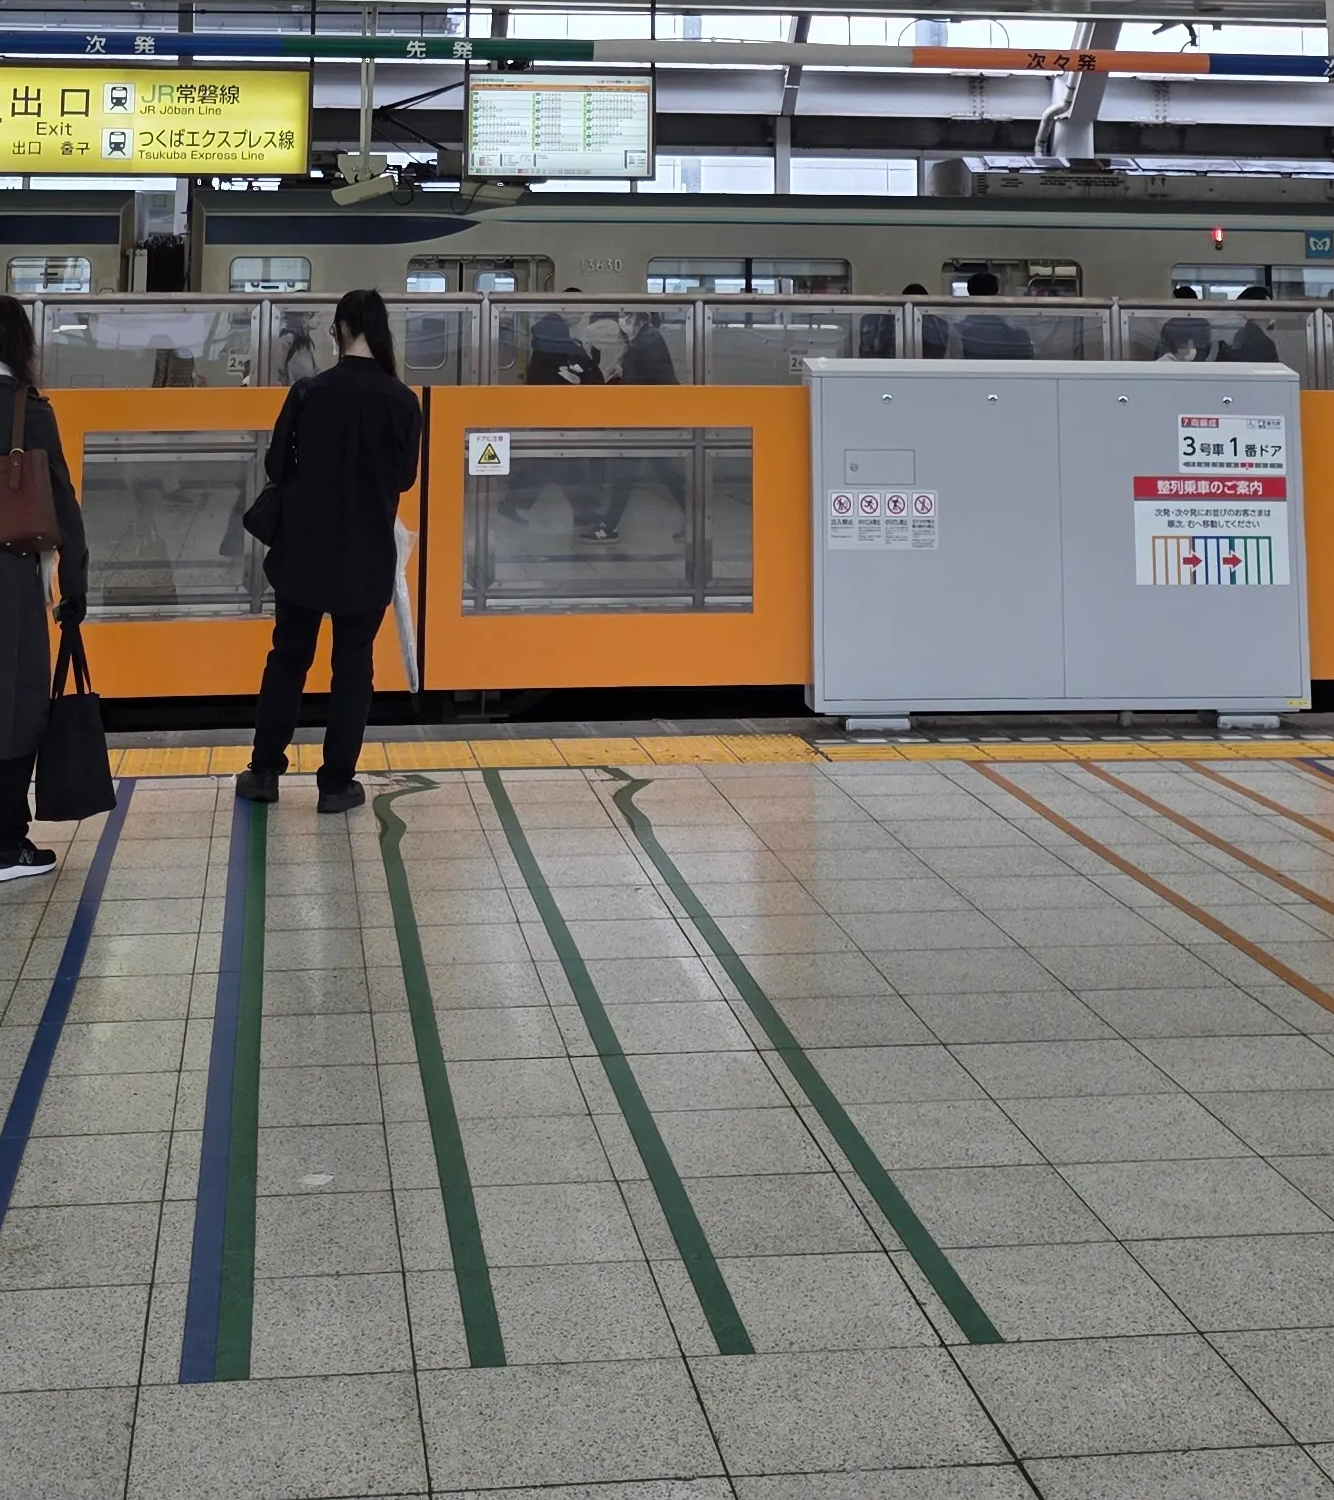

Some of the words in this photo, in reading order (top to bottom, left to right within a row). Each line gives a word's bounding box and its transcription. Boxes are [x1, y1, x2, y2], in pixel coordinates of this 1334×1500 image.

[85, 35, 156, 55] 次発
[406, 40, 473, 59] 先発
[1026, 53, 1097, 71] 次々発
[11, 85, 90, 117] 出口
[141, 83, 240, 105] JR常磐線
[139, 106, 156, 115] JR
[199, 106, 222, 116] Line
[36, 121, 73, 136] Exit
[12, 140, 42, 155] 出口
[139, 129, 295, 150] つくばエクスプレス線
[138, 150, 187, 160] Tsukuba
[191, 150, 238, 161] Express
[241, 150, 265, 161] Line
[581, 258, 622, 272] 13630
[1157, 480, 1263, 495] 整列乗車のご案内
